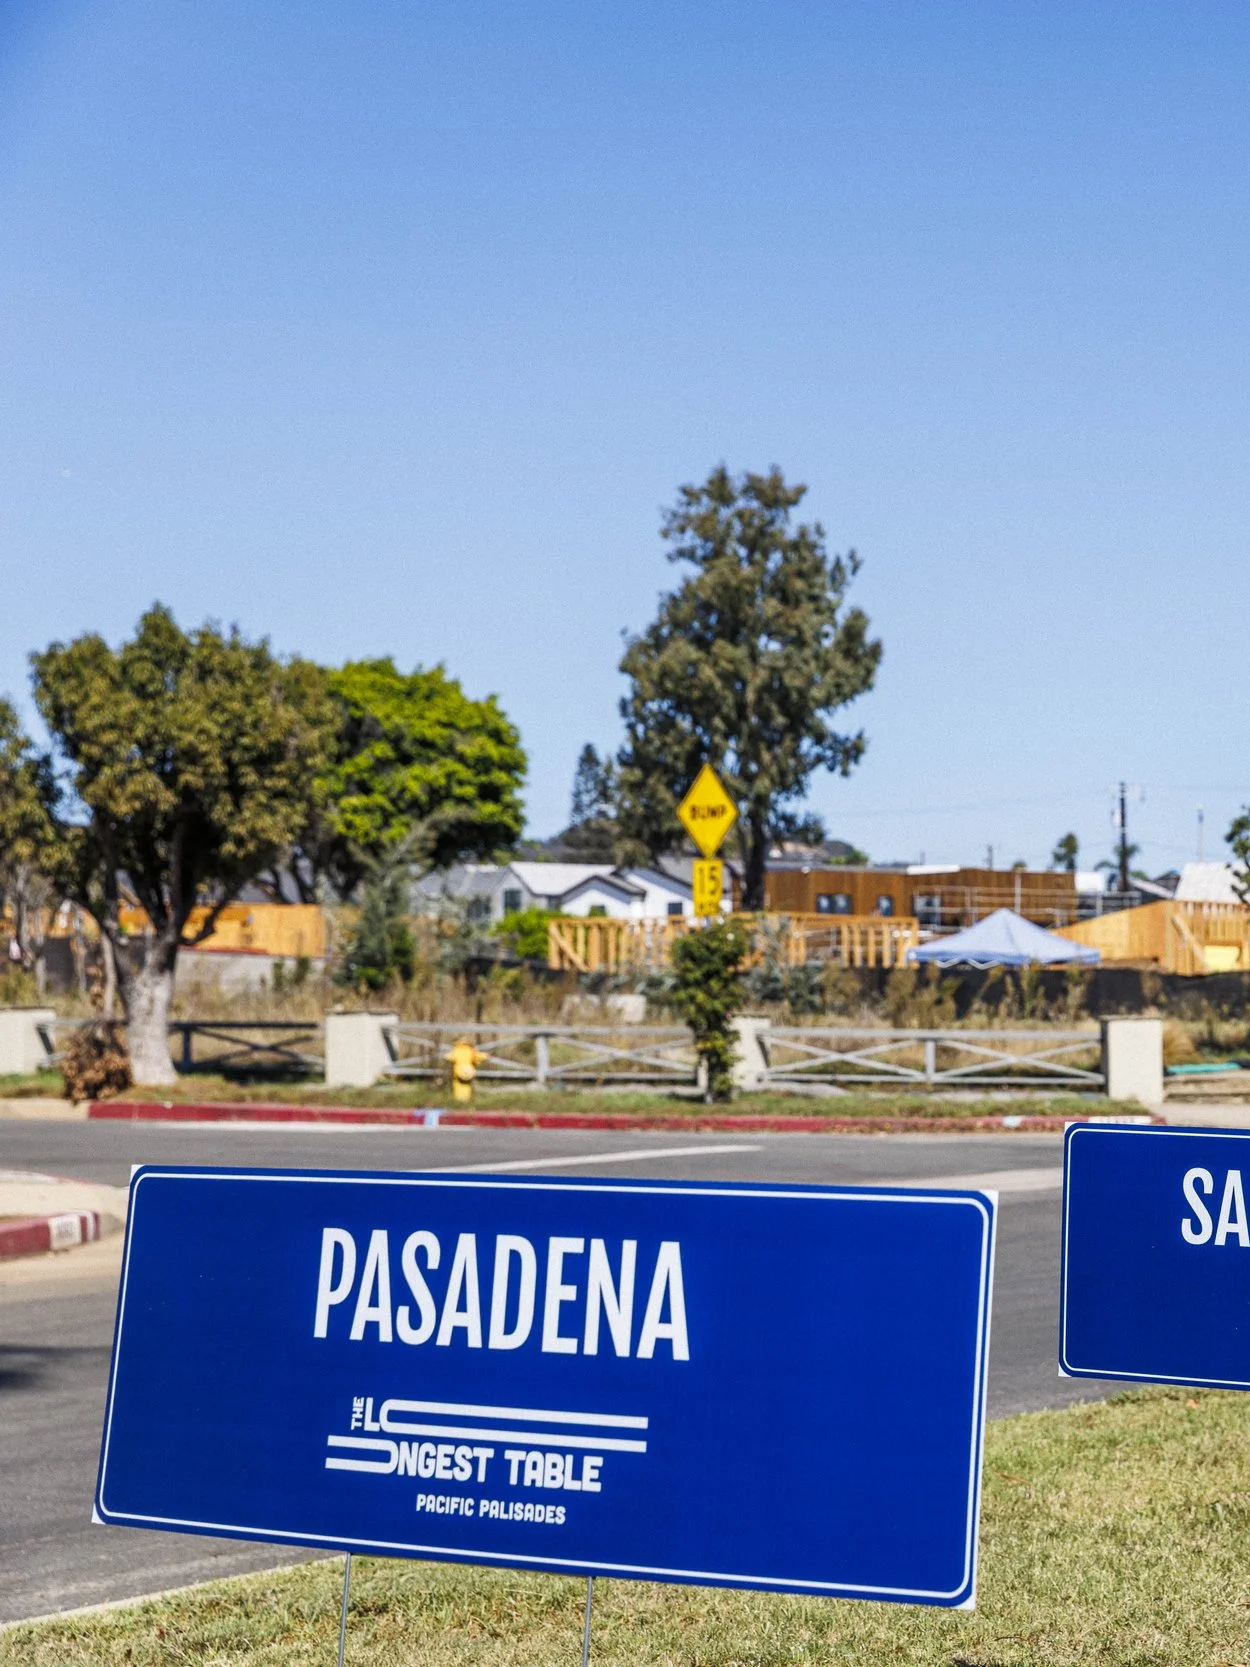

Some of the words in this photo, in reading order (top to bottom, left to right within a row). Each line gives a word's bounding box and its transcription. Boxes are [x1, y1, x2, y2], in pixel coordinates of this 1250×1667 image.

[698, 865, 721, 895] 15
[314, 1228, 689, 1360] PASADENA
[351, 1396, 364, 1430] THE
[504, 1449, 604, 1492] TABLE
[416, 1494, 475, 1517] PACIFIC
[479, 1499, 566, 1525] PALISADES
